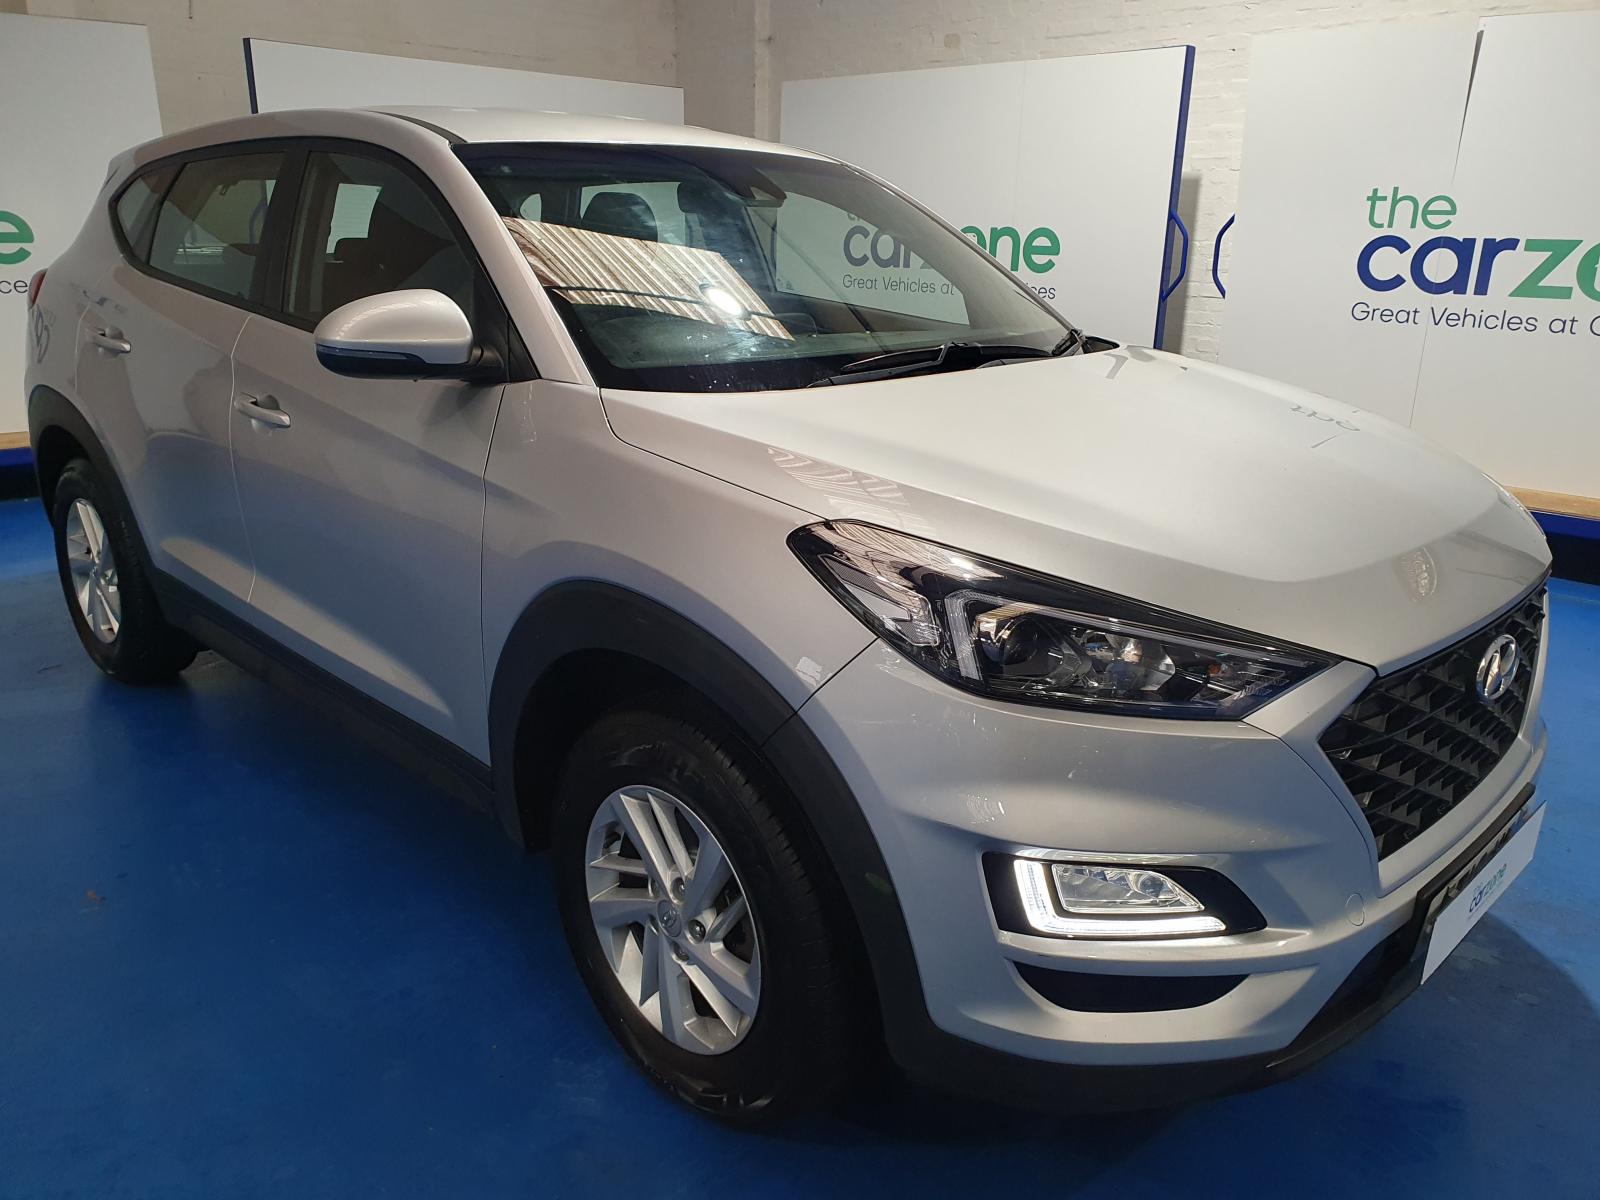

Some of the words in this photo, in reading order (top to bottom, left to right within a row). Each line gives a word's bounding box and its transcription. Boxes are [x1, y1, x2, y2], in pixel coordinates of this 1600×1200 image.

[1366, 186, 1458, 230] the
[842, 274, 878, 290] Great
[882, 276, 936, 294] Vehicles
[940, 282, 955, 296] at
[1350, 301, 1421, 326] Great
[1430, 306, 1539, 333] Vehicles
[1548, 316, 1579, 335] at
